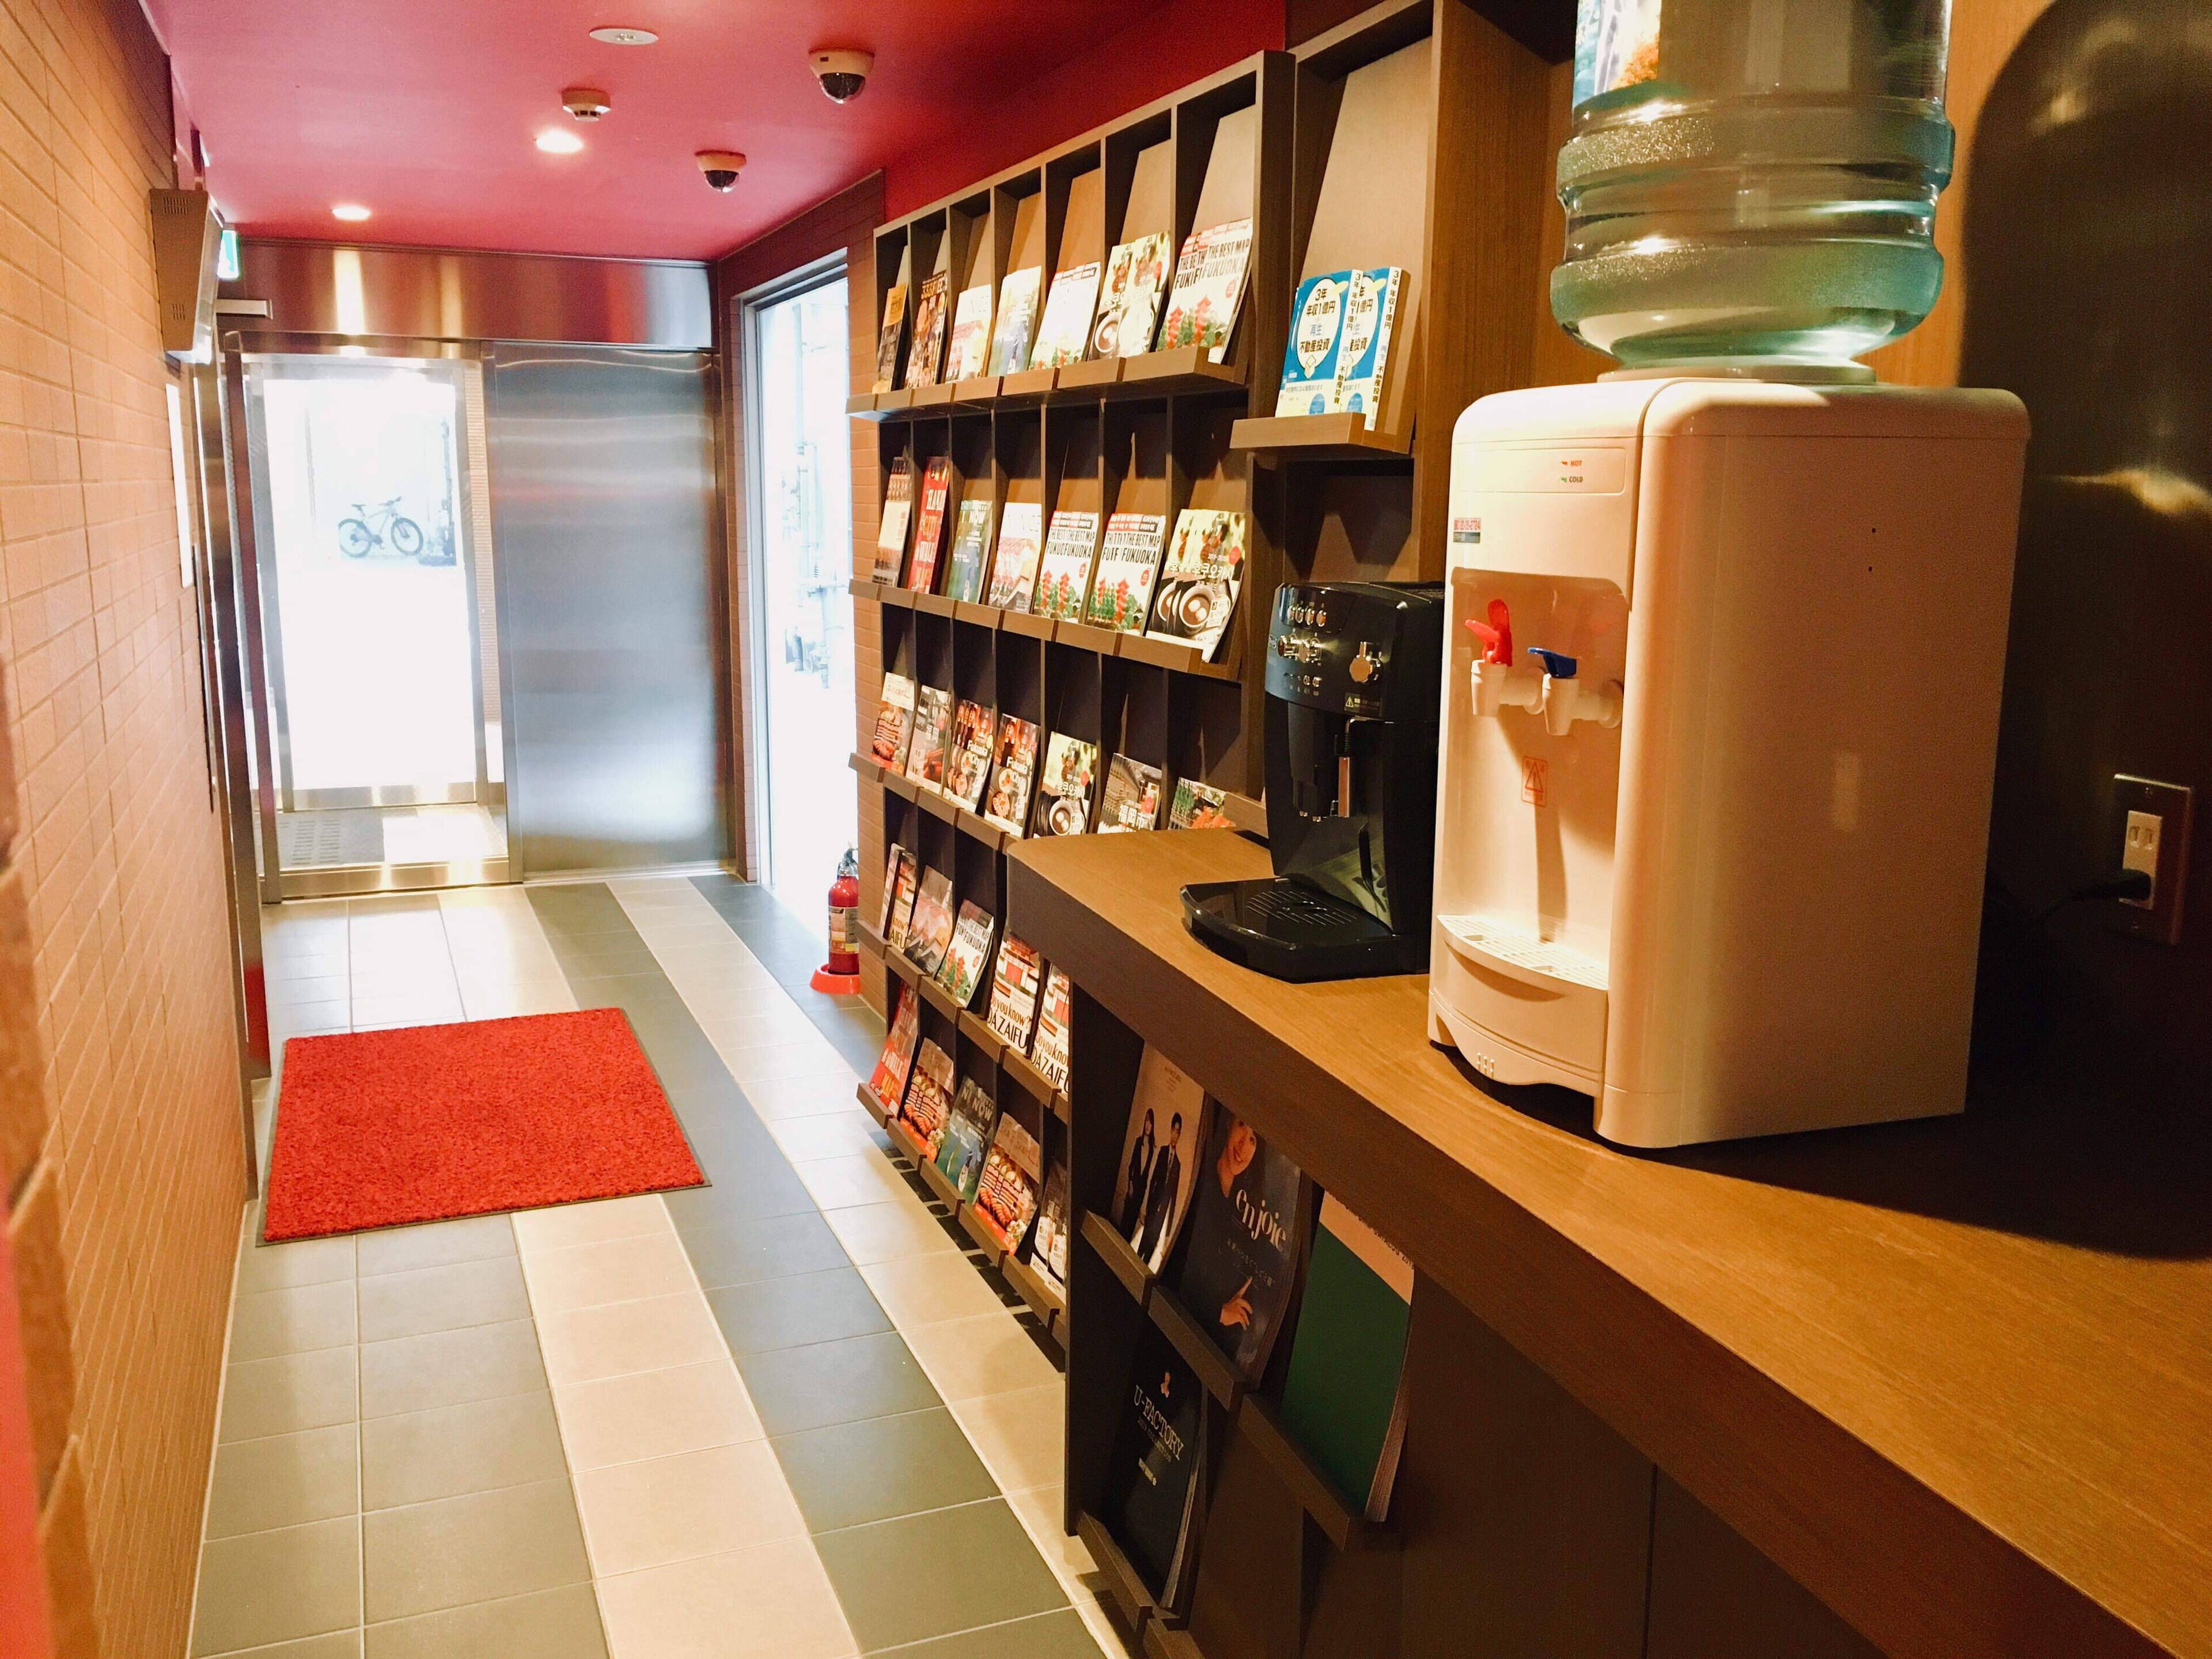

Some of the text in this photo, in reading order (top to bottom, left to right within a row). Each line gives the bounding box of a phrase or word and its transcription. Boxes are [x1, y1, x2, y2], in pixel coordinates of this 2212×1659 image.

[1209, 244, 1219, 259] THE
[1220, 241, 1235, 258] BEST
[1236, 238, 1250, 254] MAP
[1202, 257, 1245, 278] FUKUOKA
[1086, 531, 1095, 543] MAP
[1135, 533, 1148, 547] BEST
[1148, 535, 1161, 548] MAP
[1064, 543, 1092, 559] FUKUOKA
[1121, 547, 1157, 565] FUKUOKA
[889, 928, 908, 949] AIFU
[995, 999, 1007, 1014] you
[987, 1008, 1027, 1049] DAZAIFU
[1041, 1039, 1053, 1055] you
[1052, 1043, 1067, 1066] kno
[972, 1097, 993, 1122] NOW
[1236, 1189, 1286, 1252] enjoie
[1134, 1384, 1184, 1461] U-FACTORY
